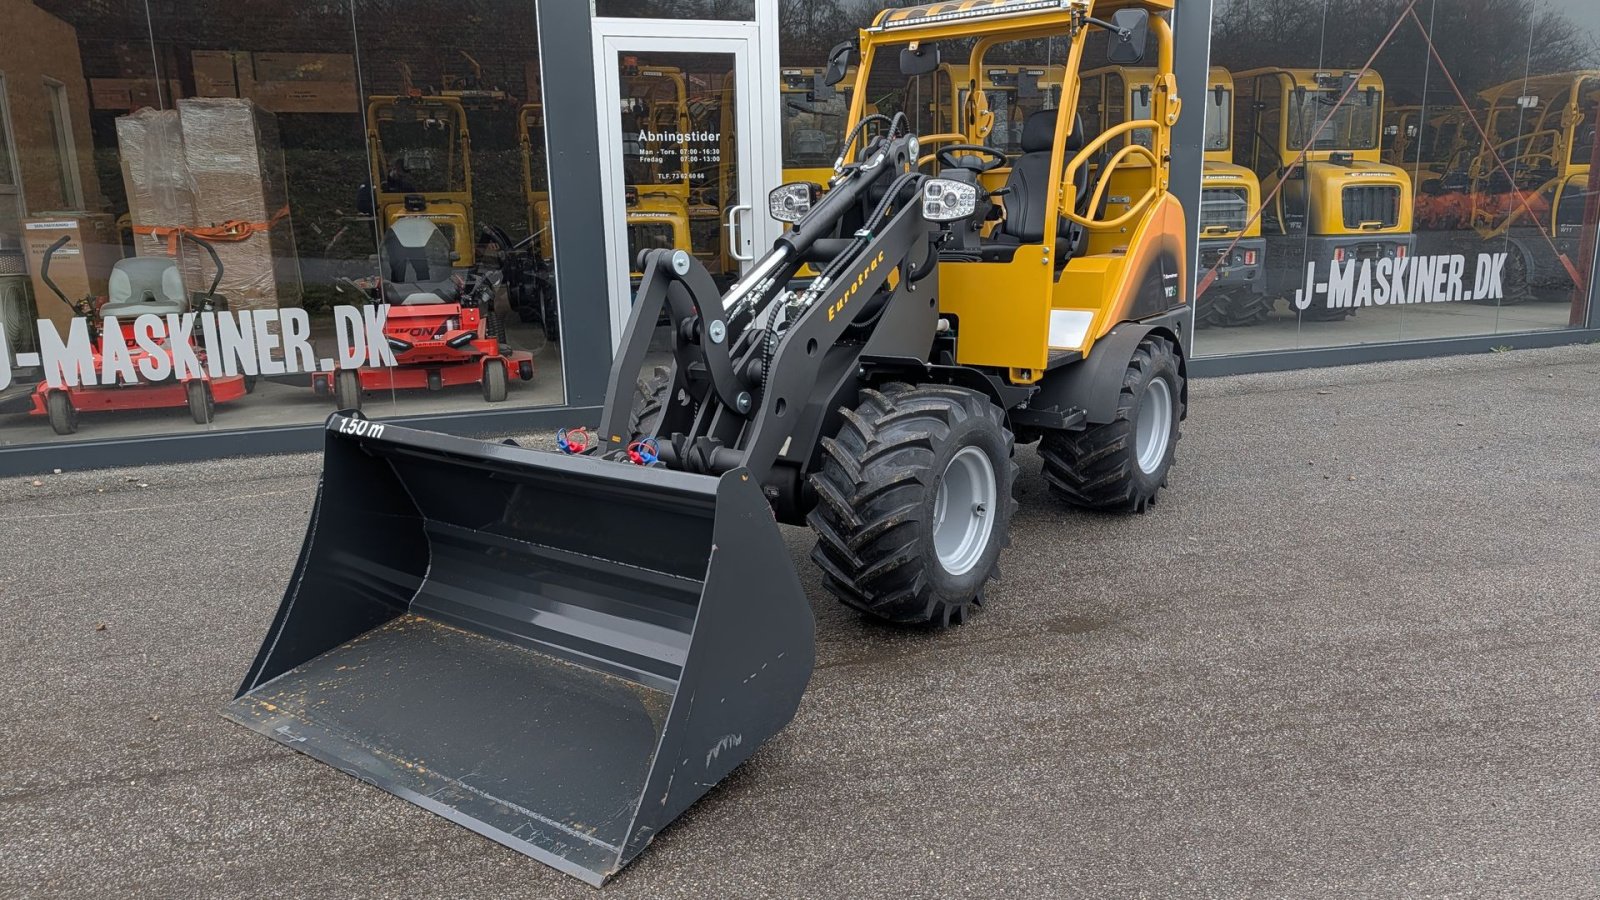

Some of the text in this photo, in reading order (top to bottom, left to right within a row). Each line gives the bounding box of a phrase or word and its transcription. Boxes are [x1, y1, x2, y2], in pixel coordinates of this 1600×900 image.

[828, 250, 884, 322] Eurotrac
[1295, 252, 1508, 310] J-MASKINER.DK
[0, 304, 398, 391] -MASKINER.DK
[339, 417, 385, 439] 1.50 m
